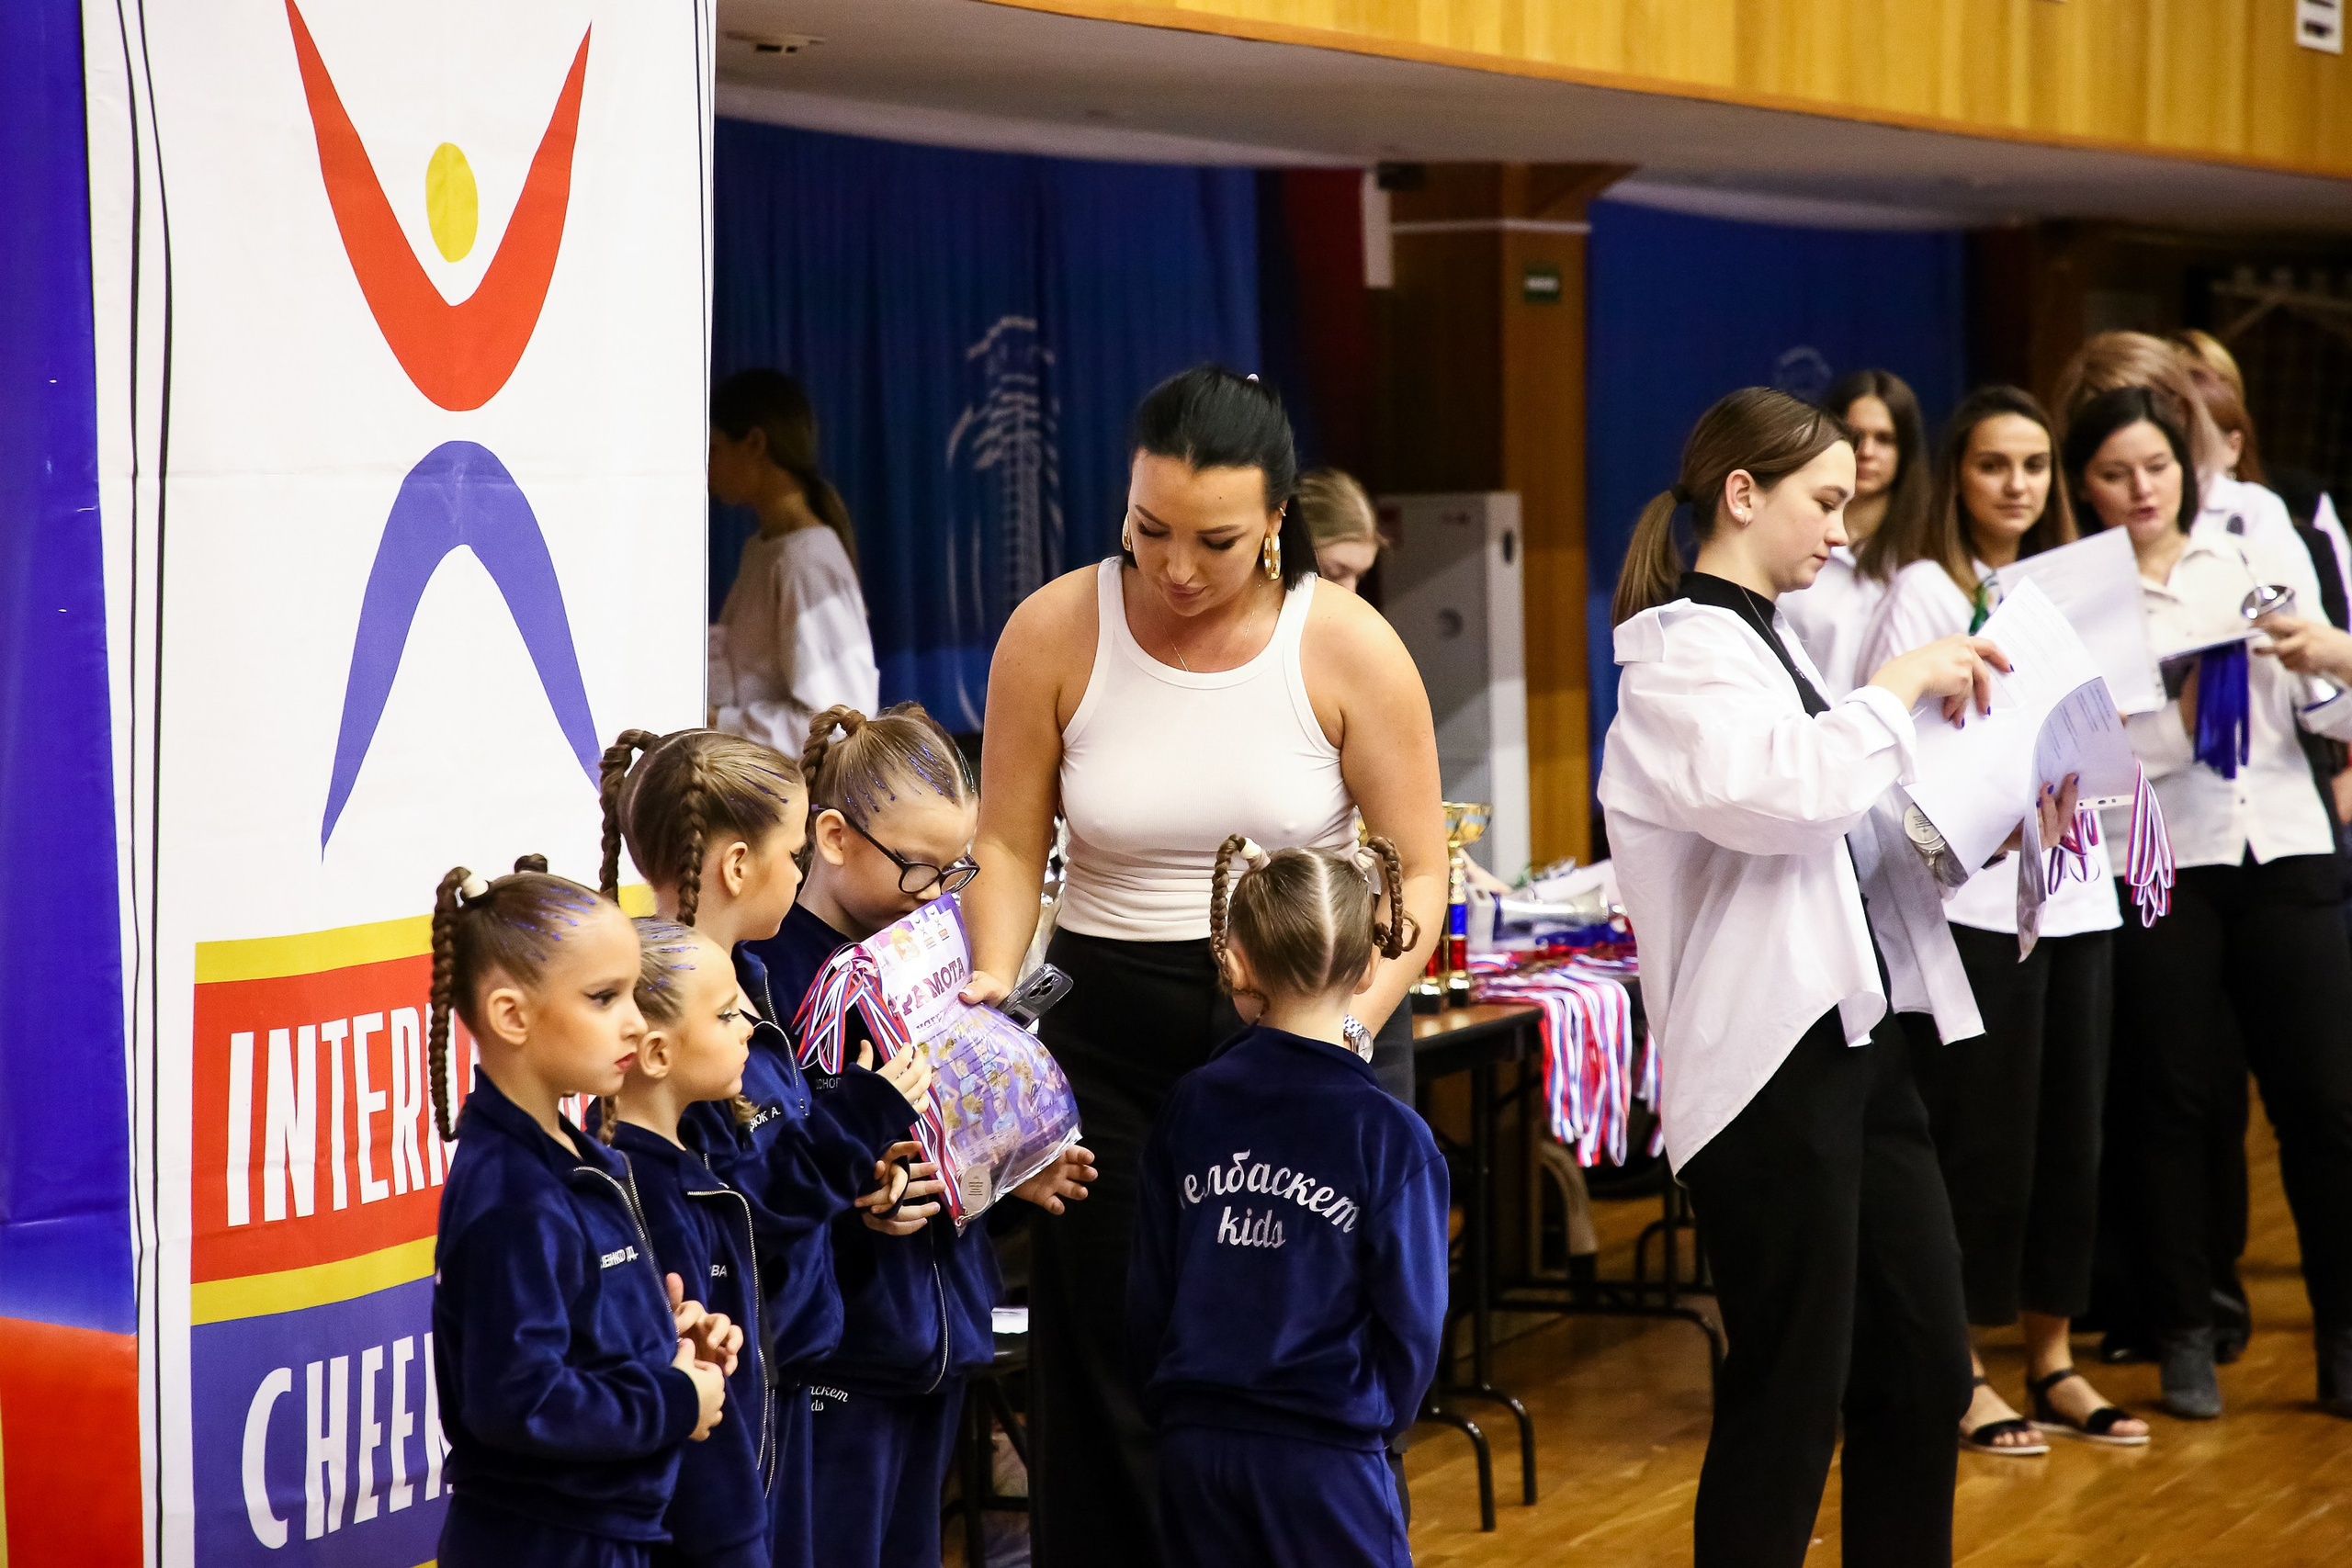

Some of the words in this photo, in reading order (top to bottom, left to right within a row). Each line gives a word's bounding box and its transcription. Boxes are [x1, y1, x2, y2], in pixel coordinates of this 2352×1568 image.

[226, 1002, 481, 1226] INTERN
[1179, 1148, 1362, 1233] елбаскет
[1217, 1205, 1286, 1248] kids
